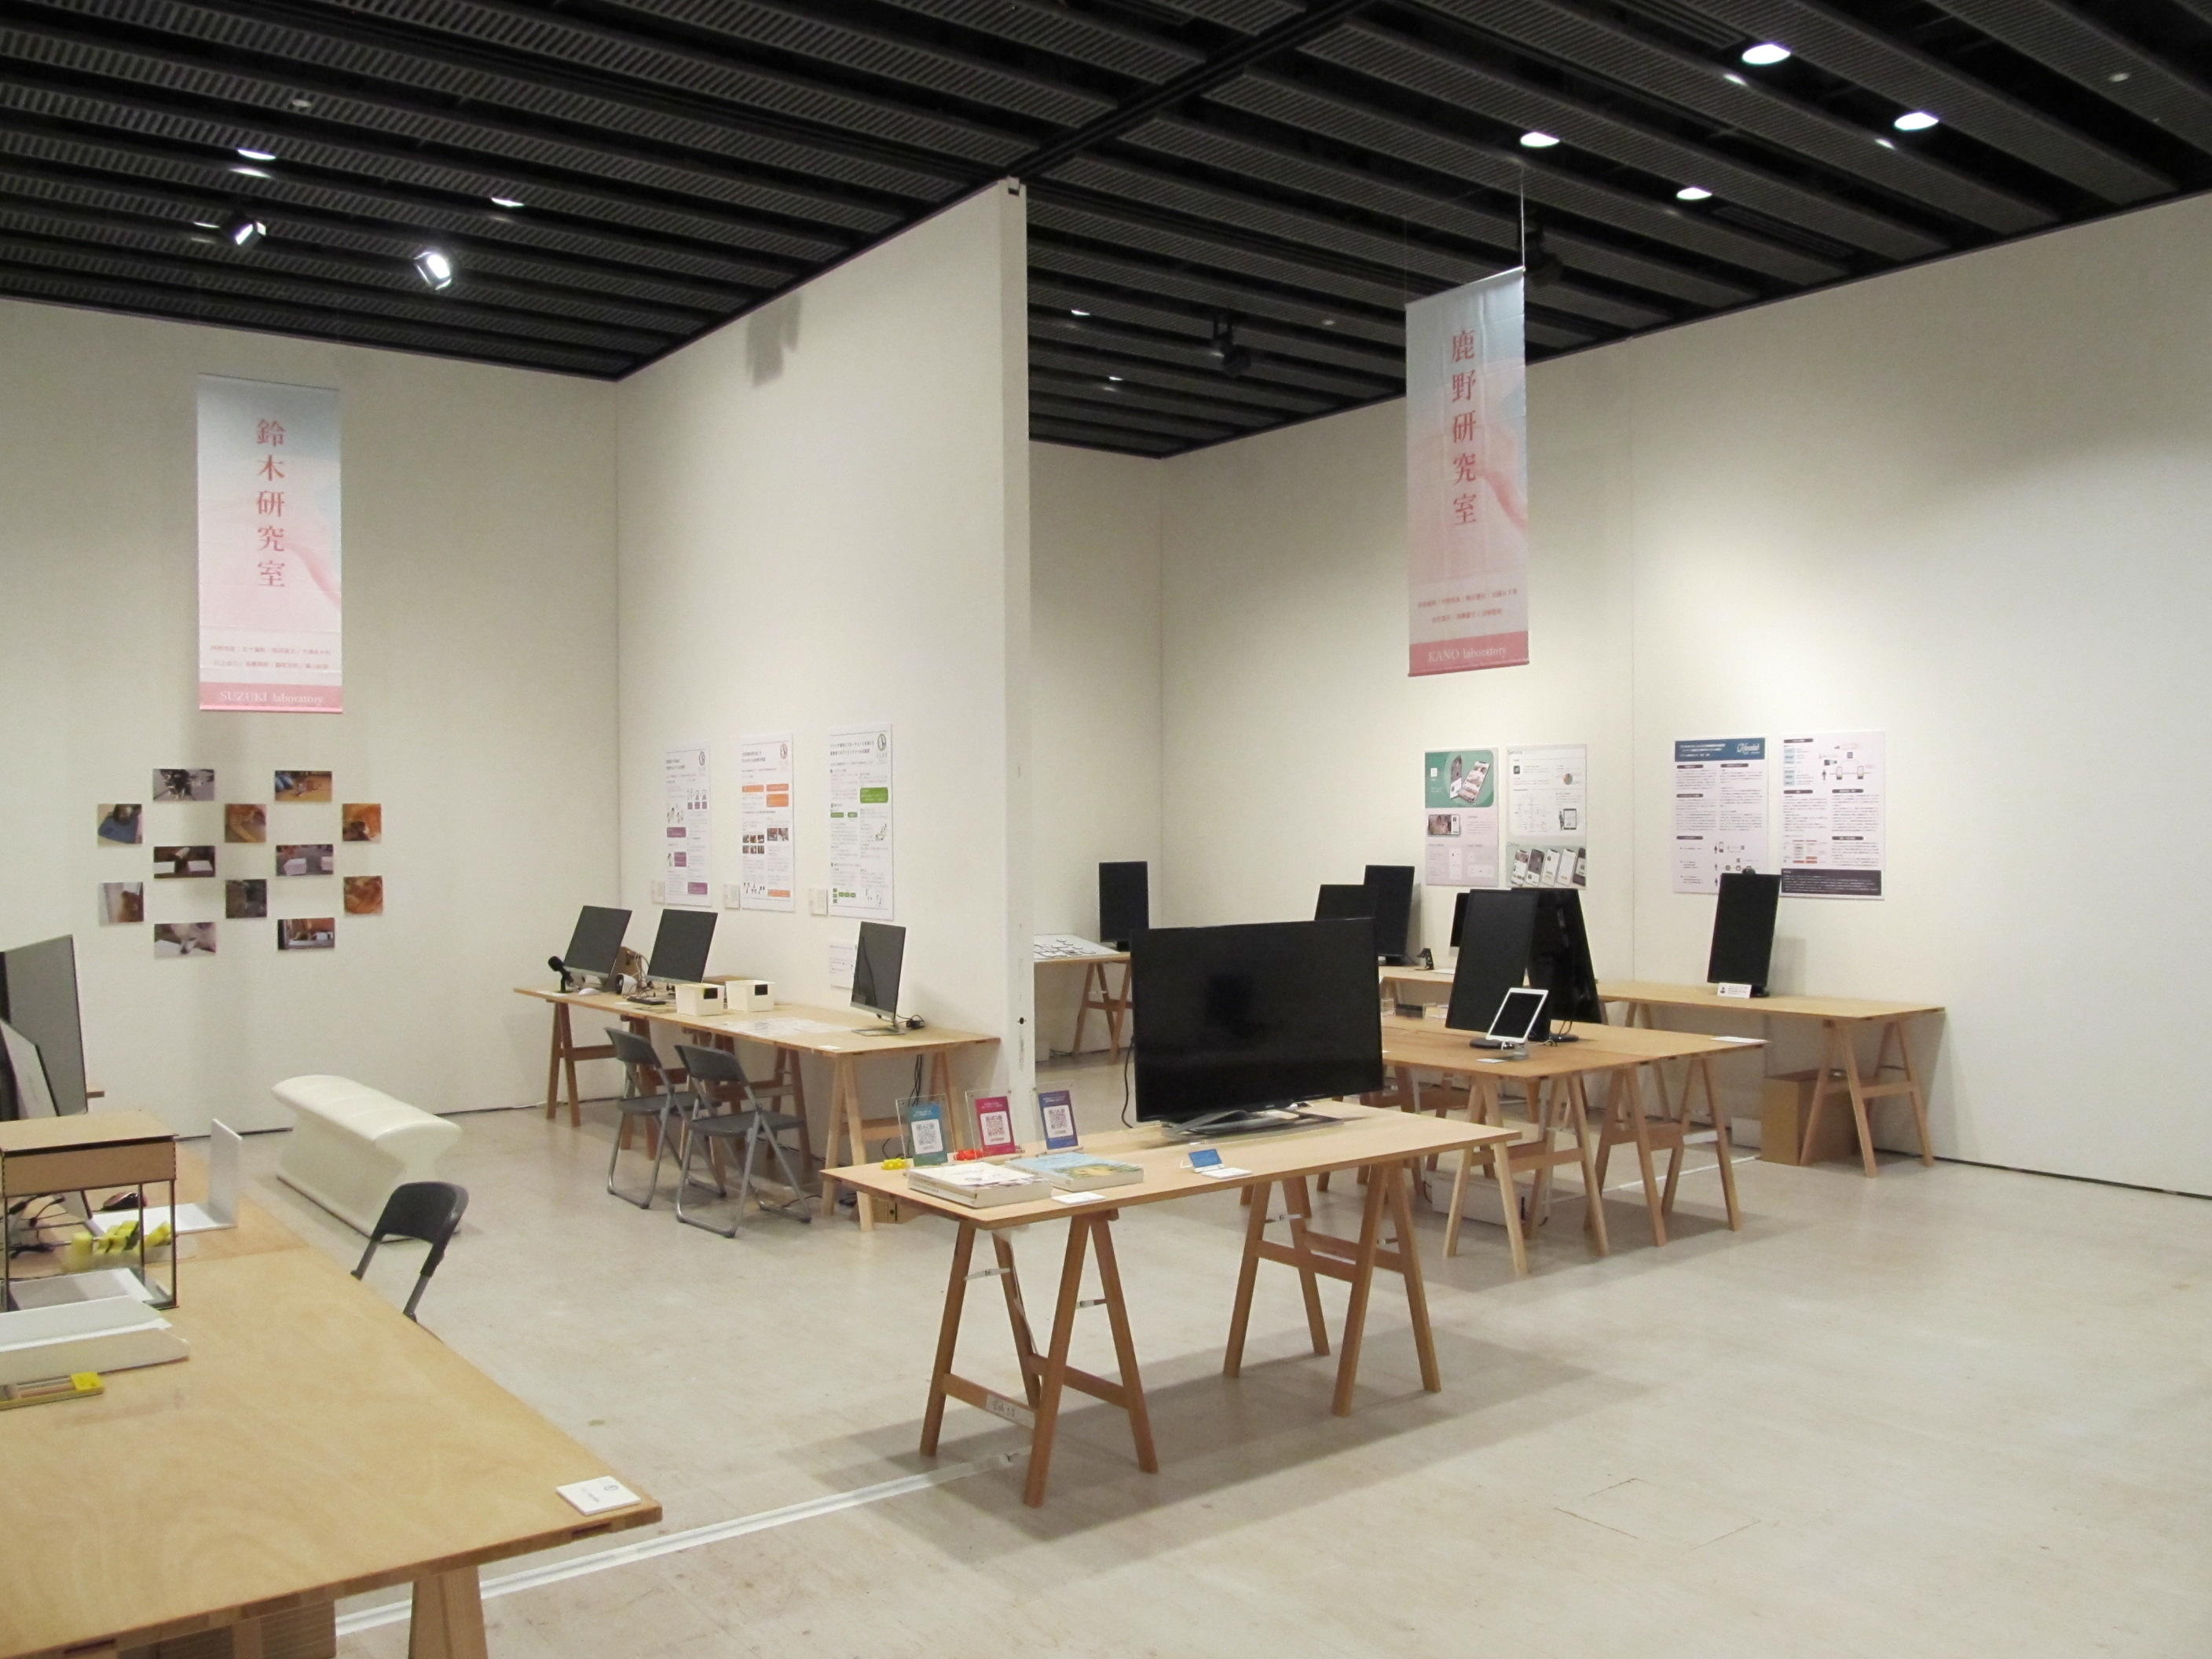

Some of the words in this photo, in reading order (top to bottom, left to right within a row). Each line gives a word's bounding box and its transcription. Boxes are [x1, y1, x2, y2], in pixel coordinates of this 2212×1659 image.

[1452, 328, 1477, 526] 鹿野研究室
[256, 418, 286, 588] 鈴木研究室
[220, 690, 267, 702] SUZUKI
[272, 692, 323, 705] laboratory
[1428, 649, 1459, 662] KANO
